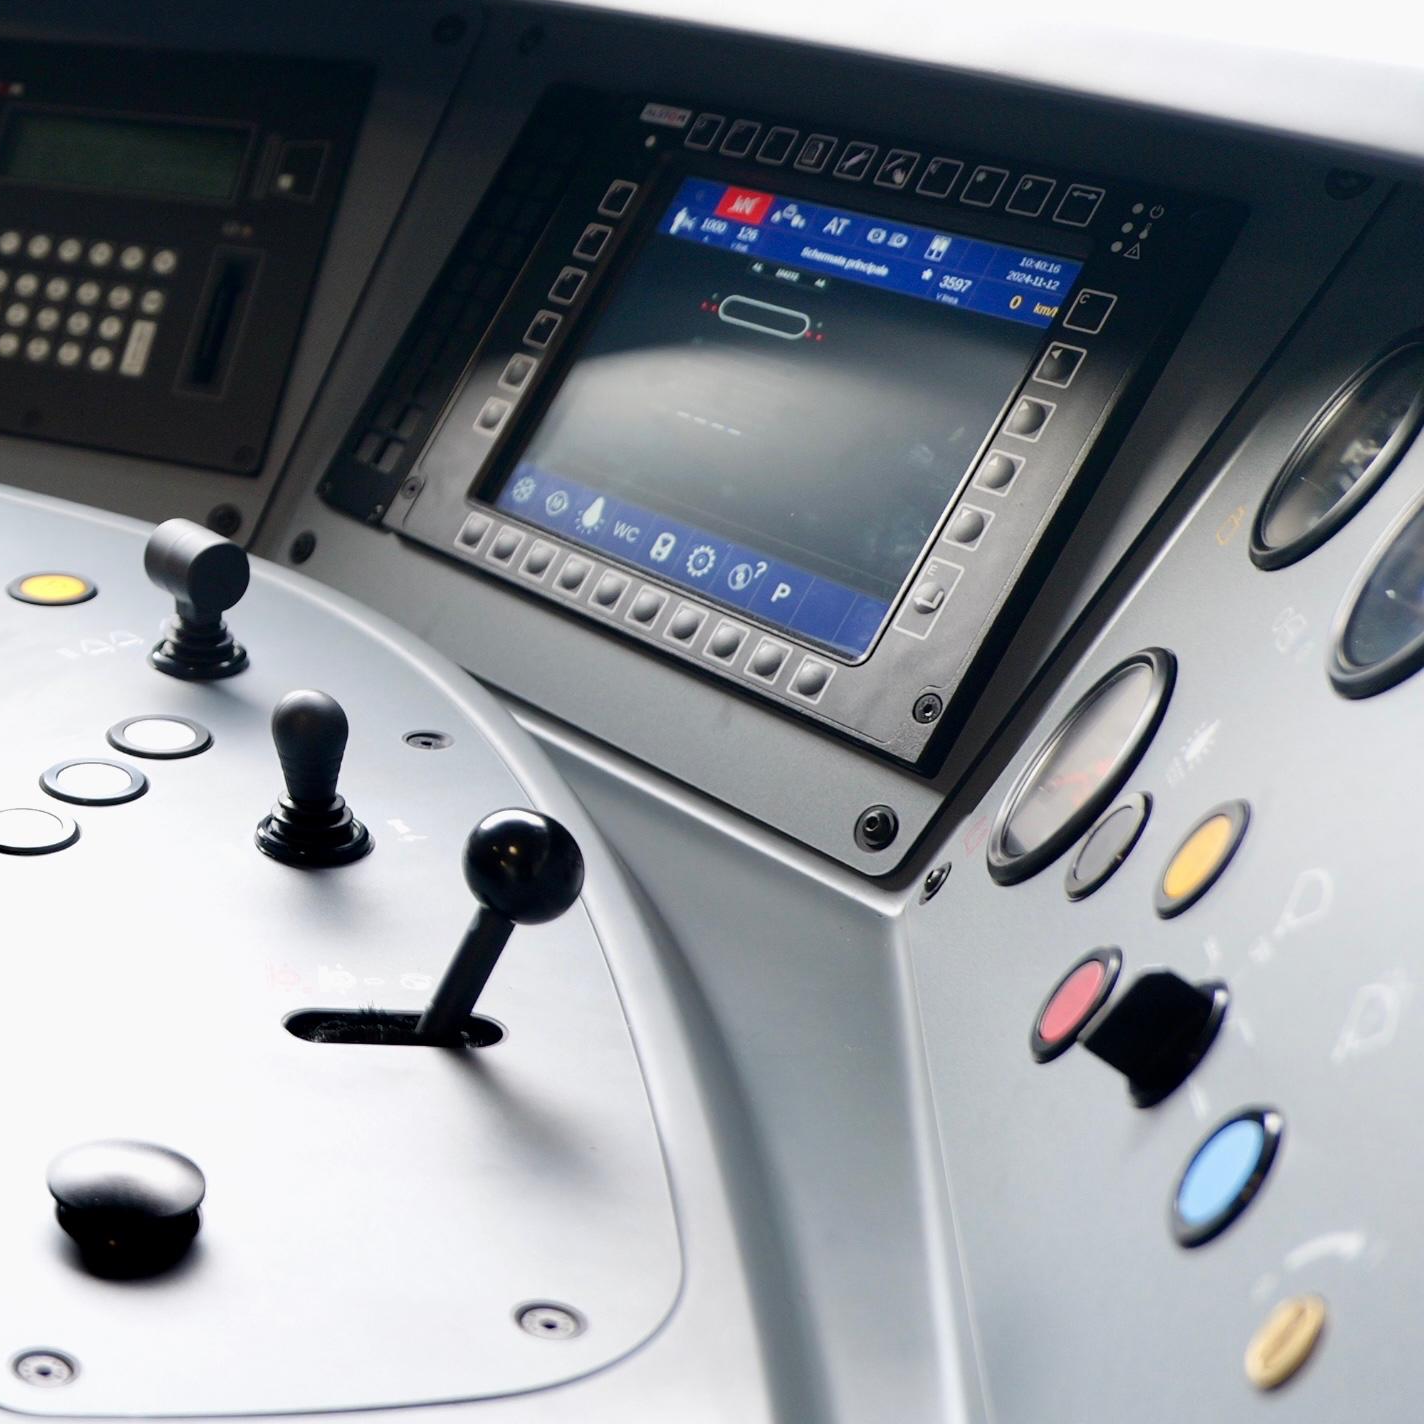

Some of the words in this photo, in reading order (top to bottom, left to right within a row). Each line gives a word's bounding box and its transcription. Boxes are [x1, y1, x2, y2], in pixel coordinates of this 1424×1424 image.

[700, 217, 729, 235] 1000
[736, 227, 760, 243] 126
[822, 216, 851, 236] AT
[800, 246, 848, 266] Schermata
[1019, 257, 1062, 274] 10:40:16
[938, 275, 973, 293] 3597
[1006, 270, 1061, 291] 2024-11-12
[1009, 295, 1023, 310] 0
[1079, 294, 1091, 304] C
[612, 520, 641, 543] WC
[770, 583, 792, 603] P
